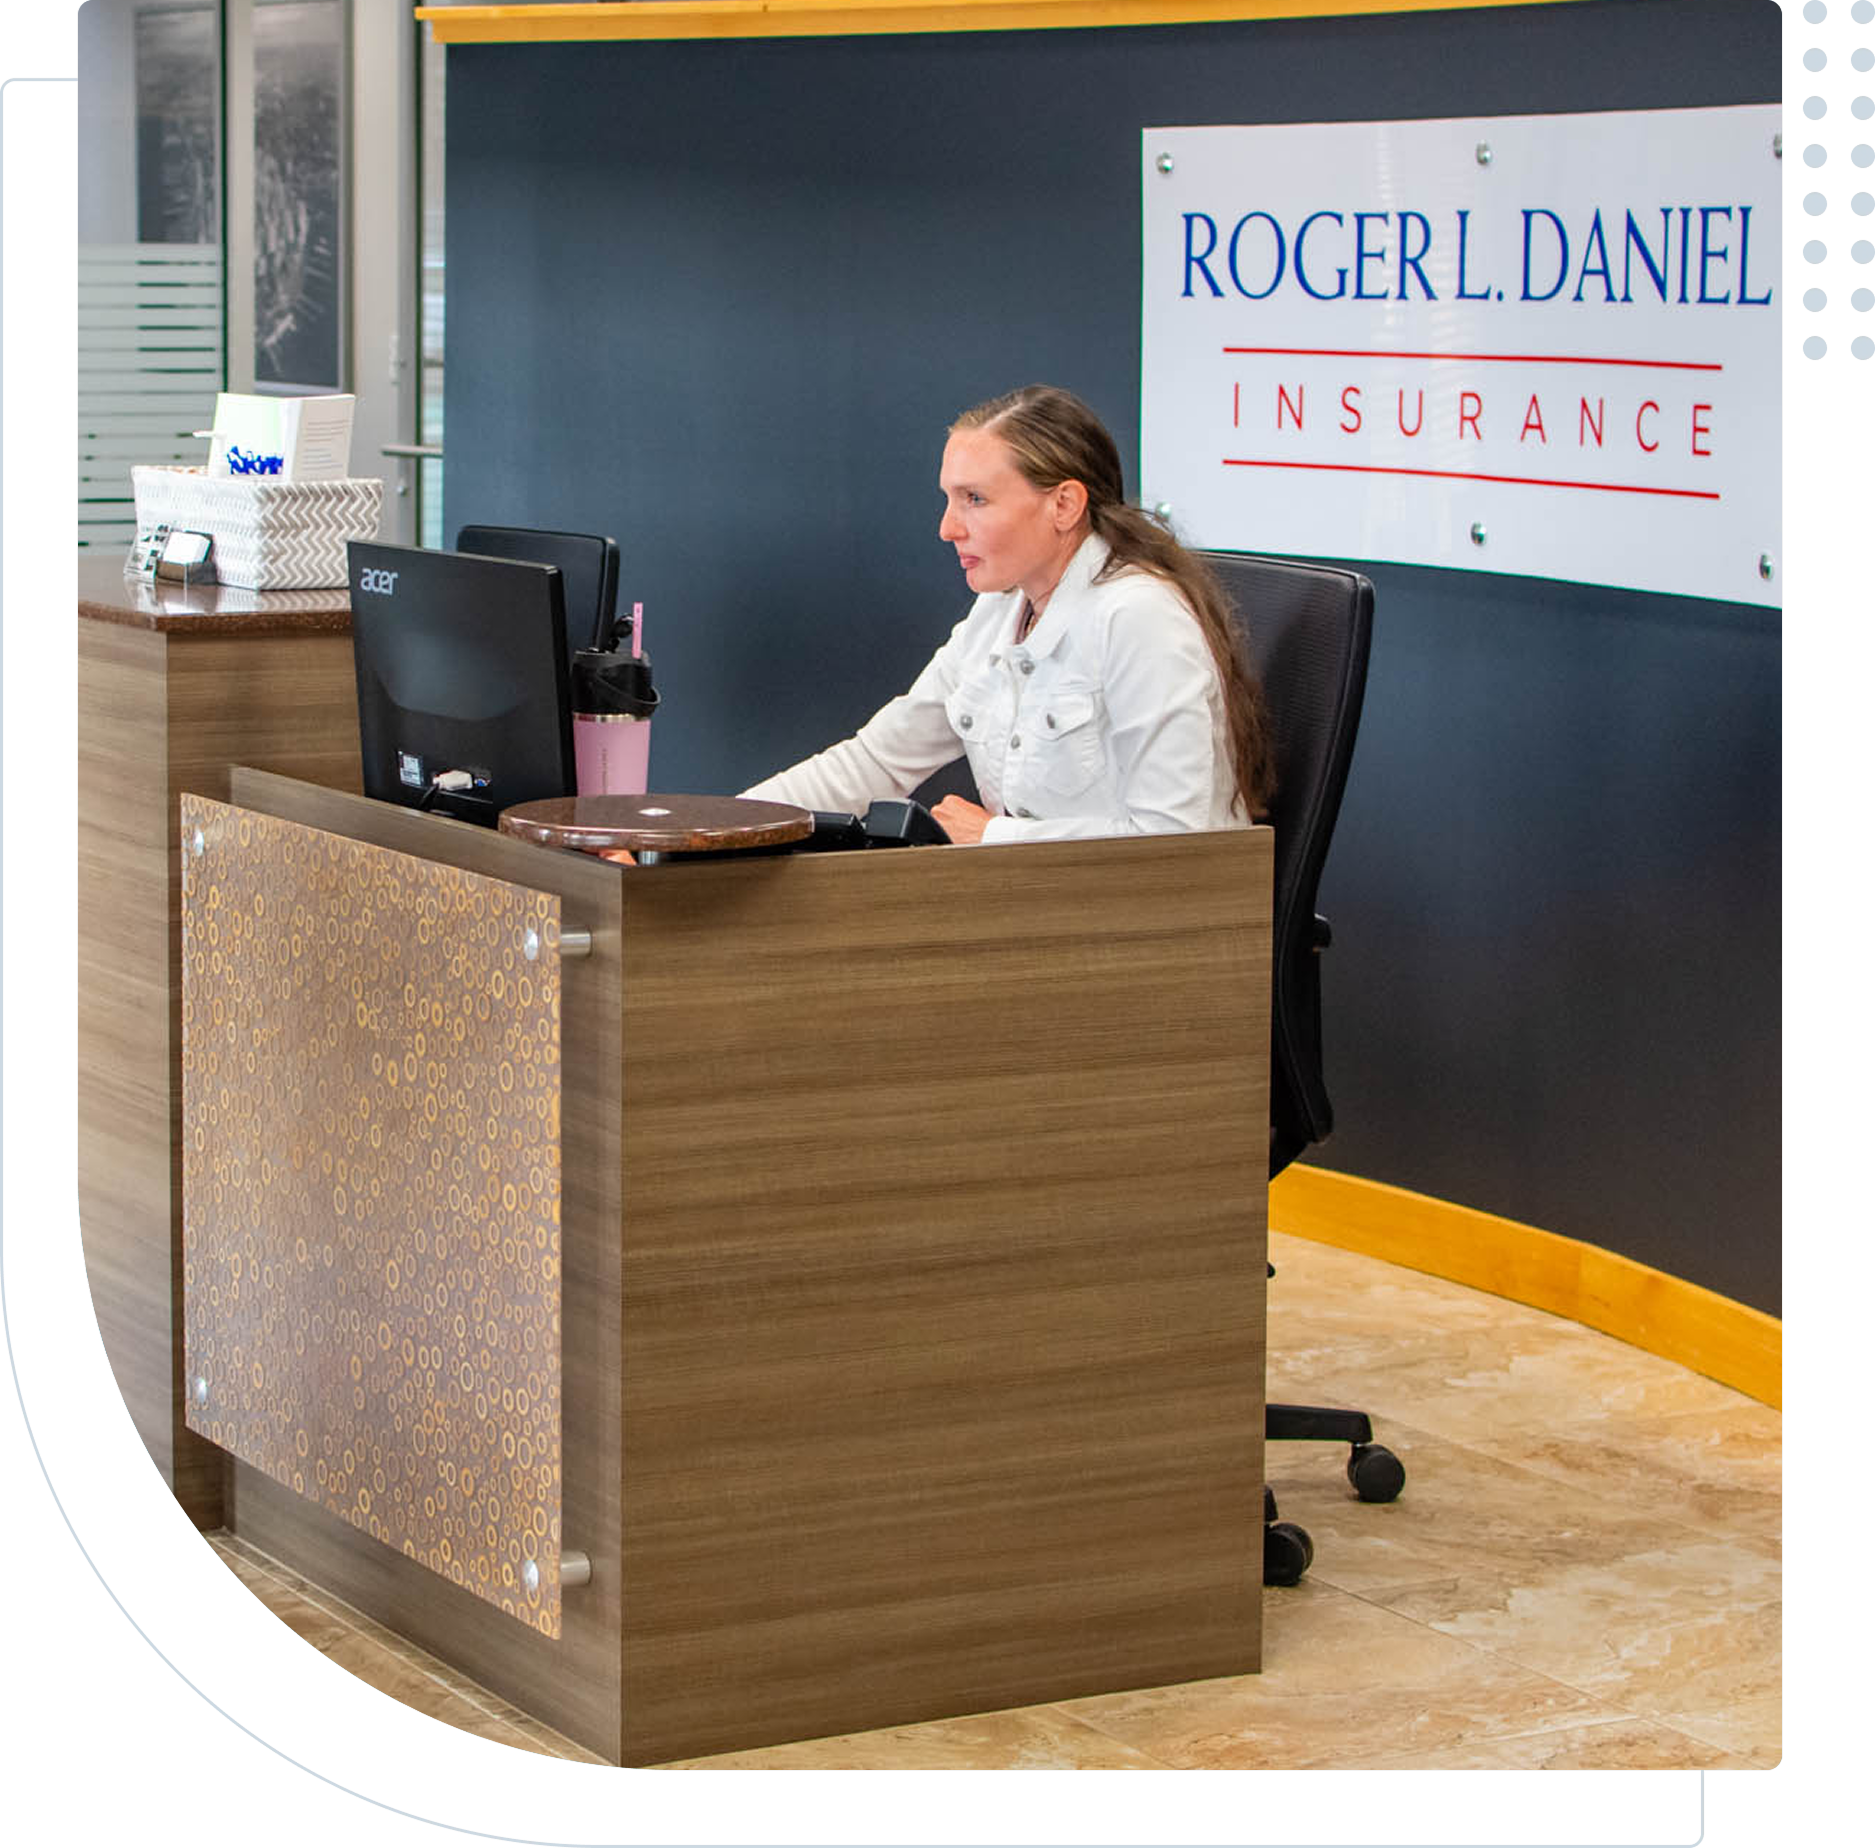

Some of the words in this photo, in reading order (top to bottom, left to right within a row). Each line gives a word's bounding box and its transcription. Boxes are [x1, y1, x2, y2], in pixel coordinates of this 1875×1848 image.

[1181, 209, 1438, 302] ROGER
[1455, 208, 1505, 302] L.
[1520, 204, 1773, 306] DANIEL
[1233, 381, 1713, 457] INSURANCE
[360, 567, 399, 596] acer
